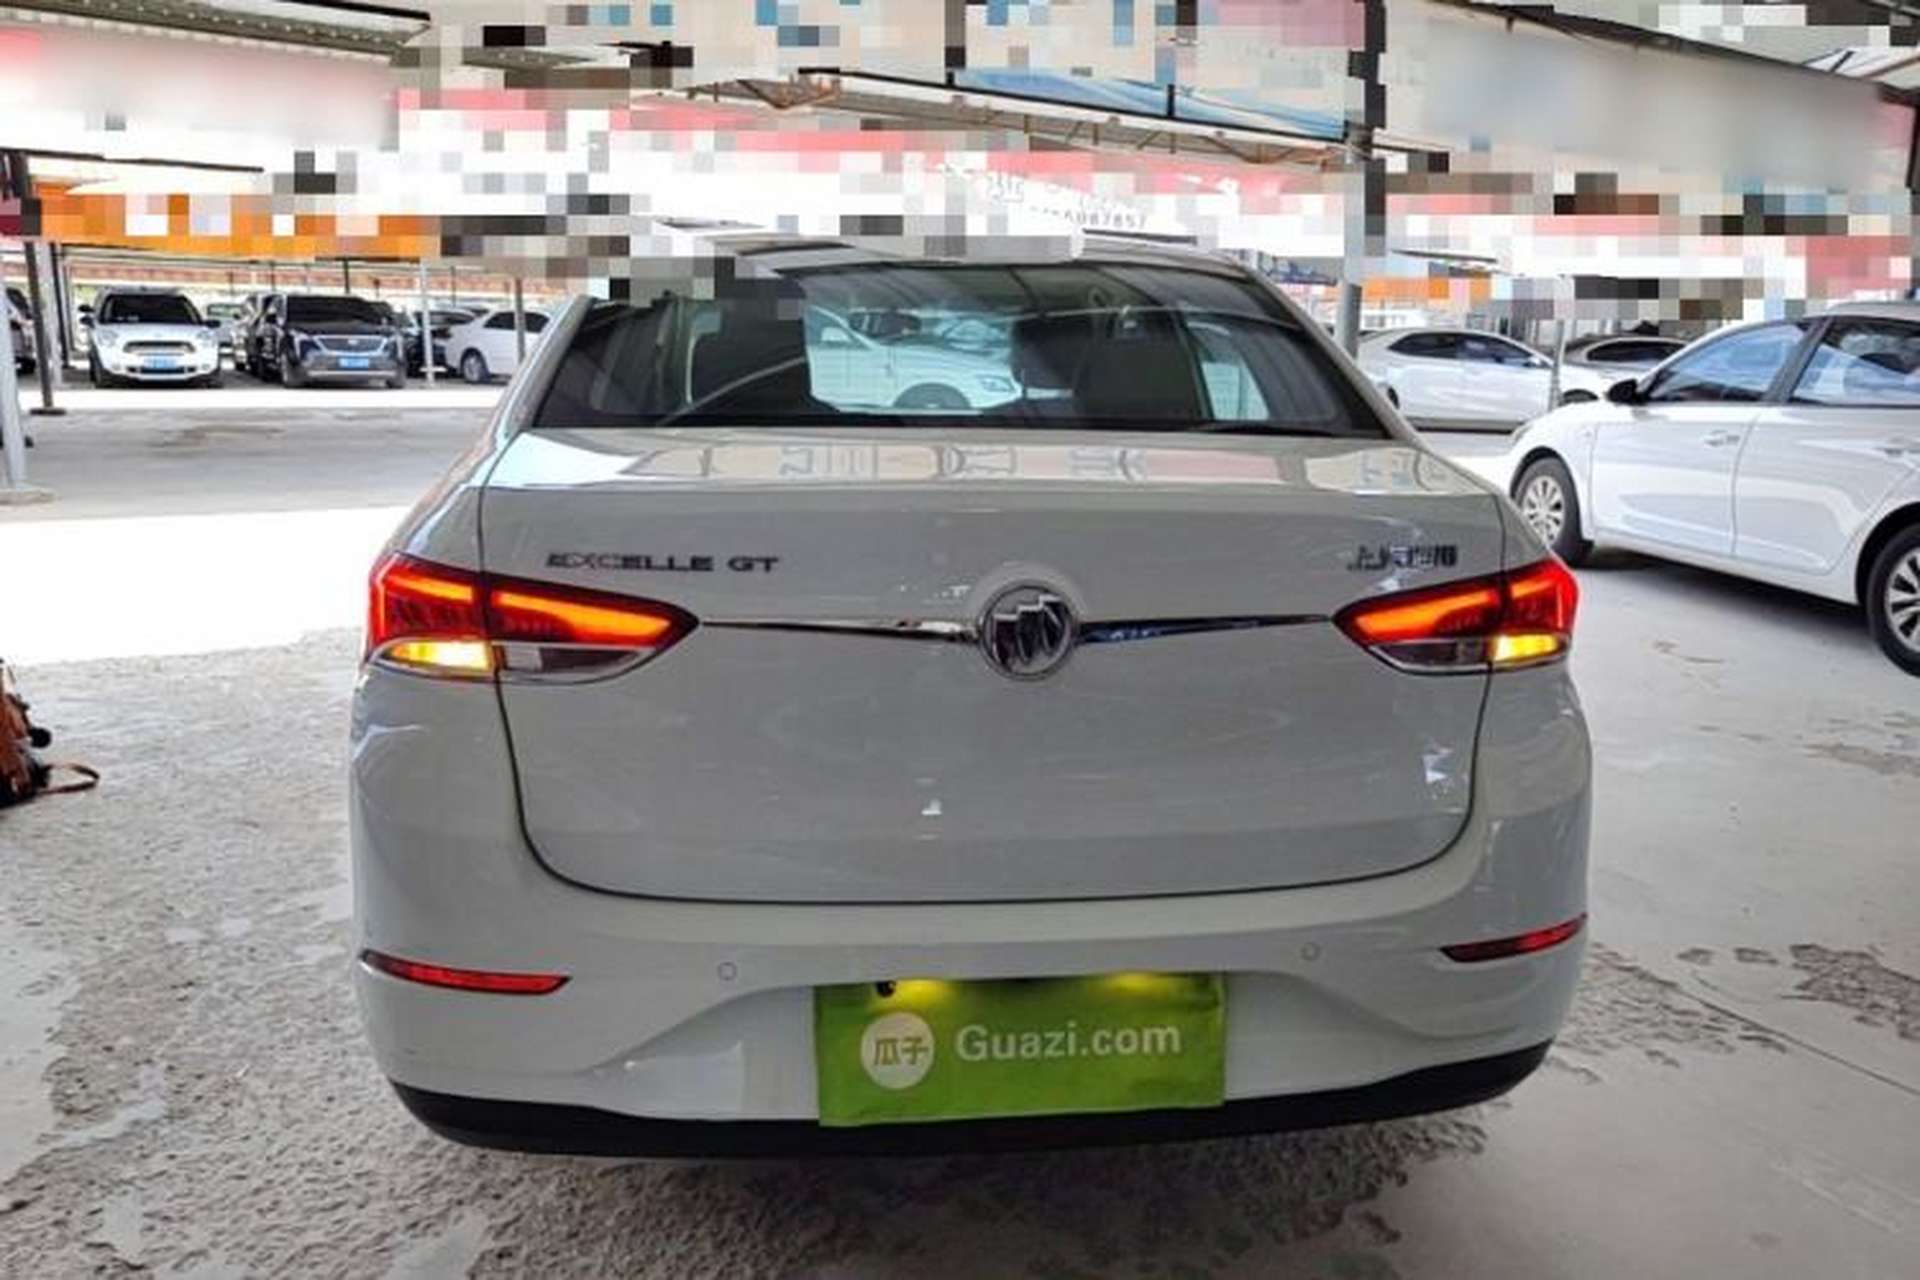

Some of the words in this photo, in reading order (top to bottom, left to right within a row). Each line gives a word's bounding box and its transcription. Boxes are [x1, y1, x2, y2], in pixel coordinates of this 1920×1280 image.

[546, 553, 714, 572] EXCELLE
[727, 557, 779, 572] GT
[873, 1035, 929, 1067] 瓜子
[956, 1021, 1181, 1063] Guazi.com
